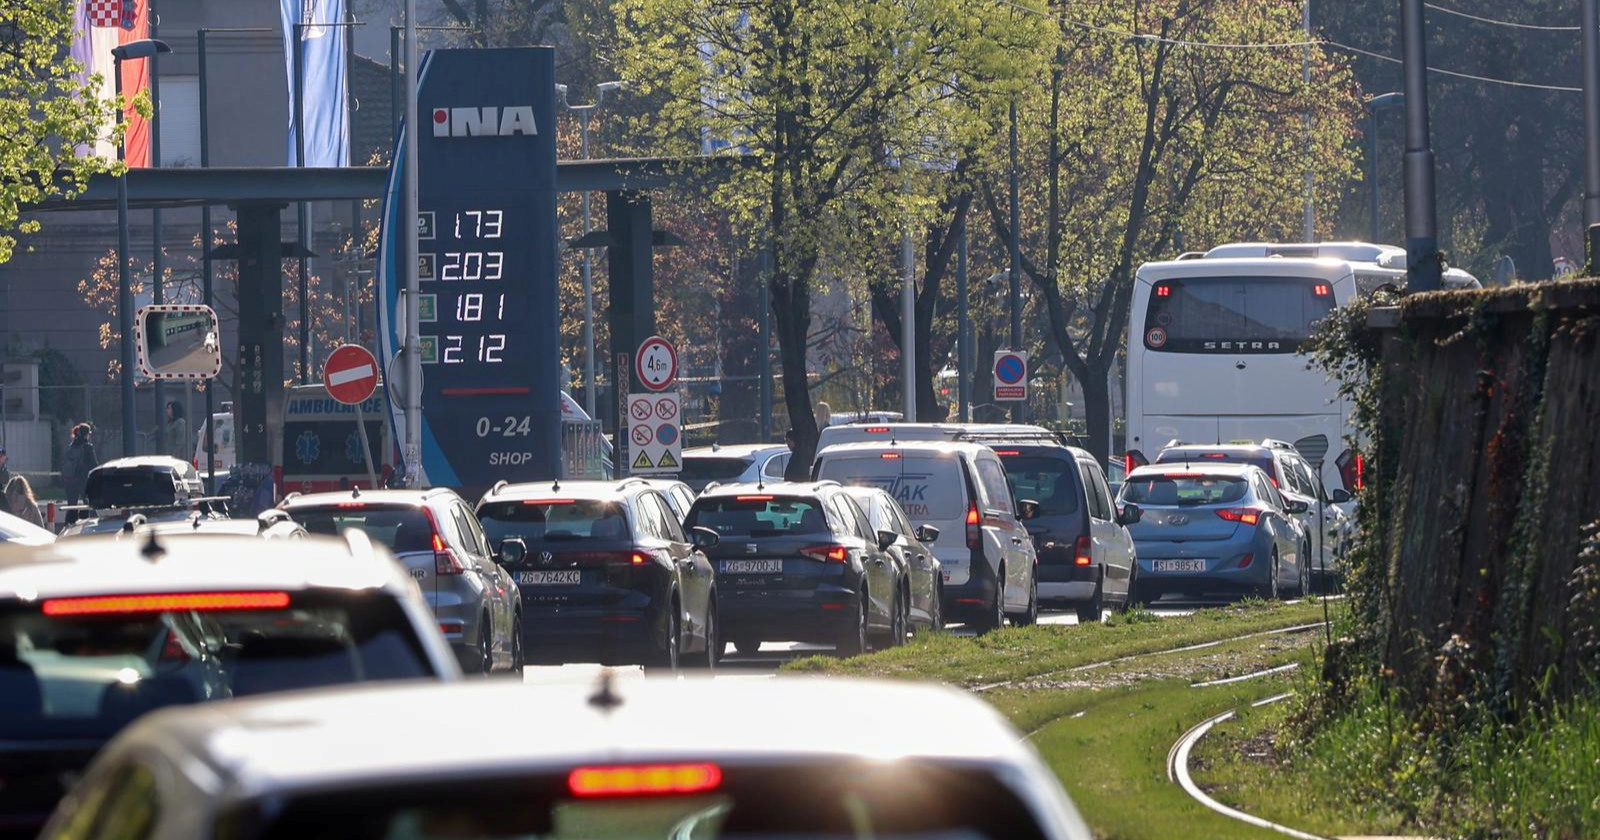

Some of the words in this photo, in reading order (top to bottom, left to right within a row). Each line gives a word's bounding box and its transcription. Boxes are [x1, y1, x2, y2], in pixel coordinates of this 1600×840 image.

[455, 210, 503, 239] 1.73
[441, 252, 504, 280] 2.03
[456, 293, 505, 321] 1.81
[444, 334, 506, 364] 2.12
[1203, 341, 1280, 349] SETRA
[288, 398, 382, 415] AMBULACE
[489, 452, 532, 465] SHOP
[727, 560, 739, 571] ZG
[1159, 561, 1168, 571] SI
[521, 571, 534, 583] ZG
